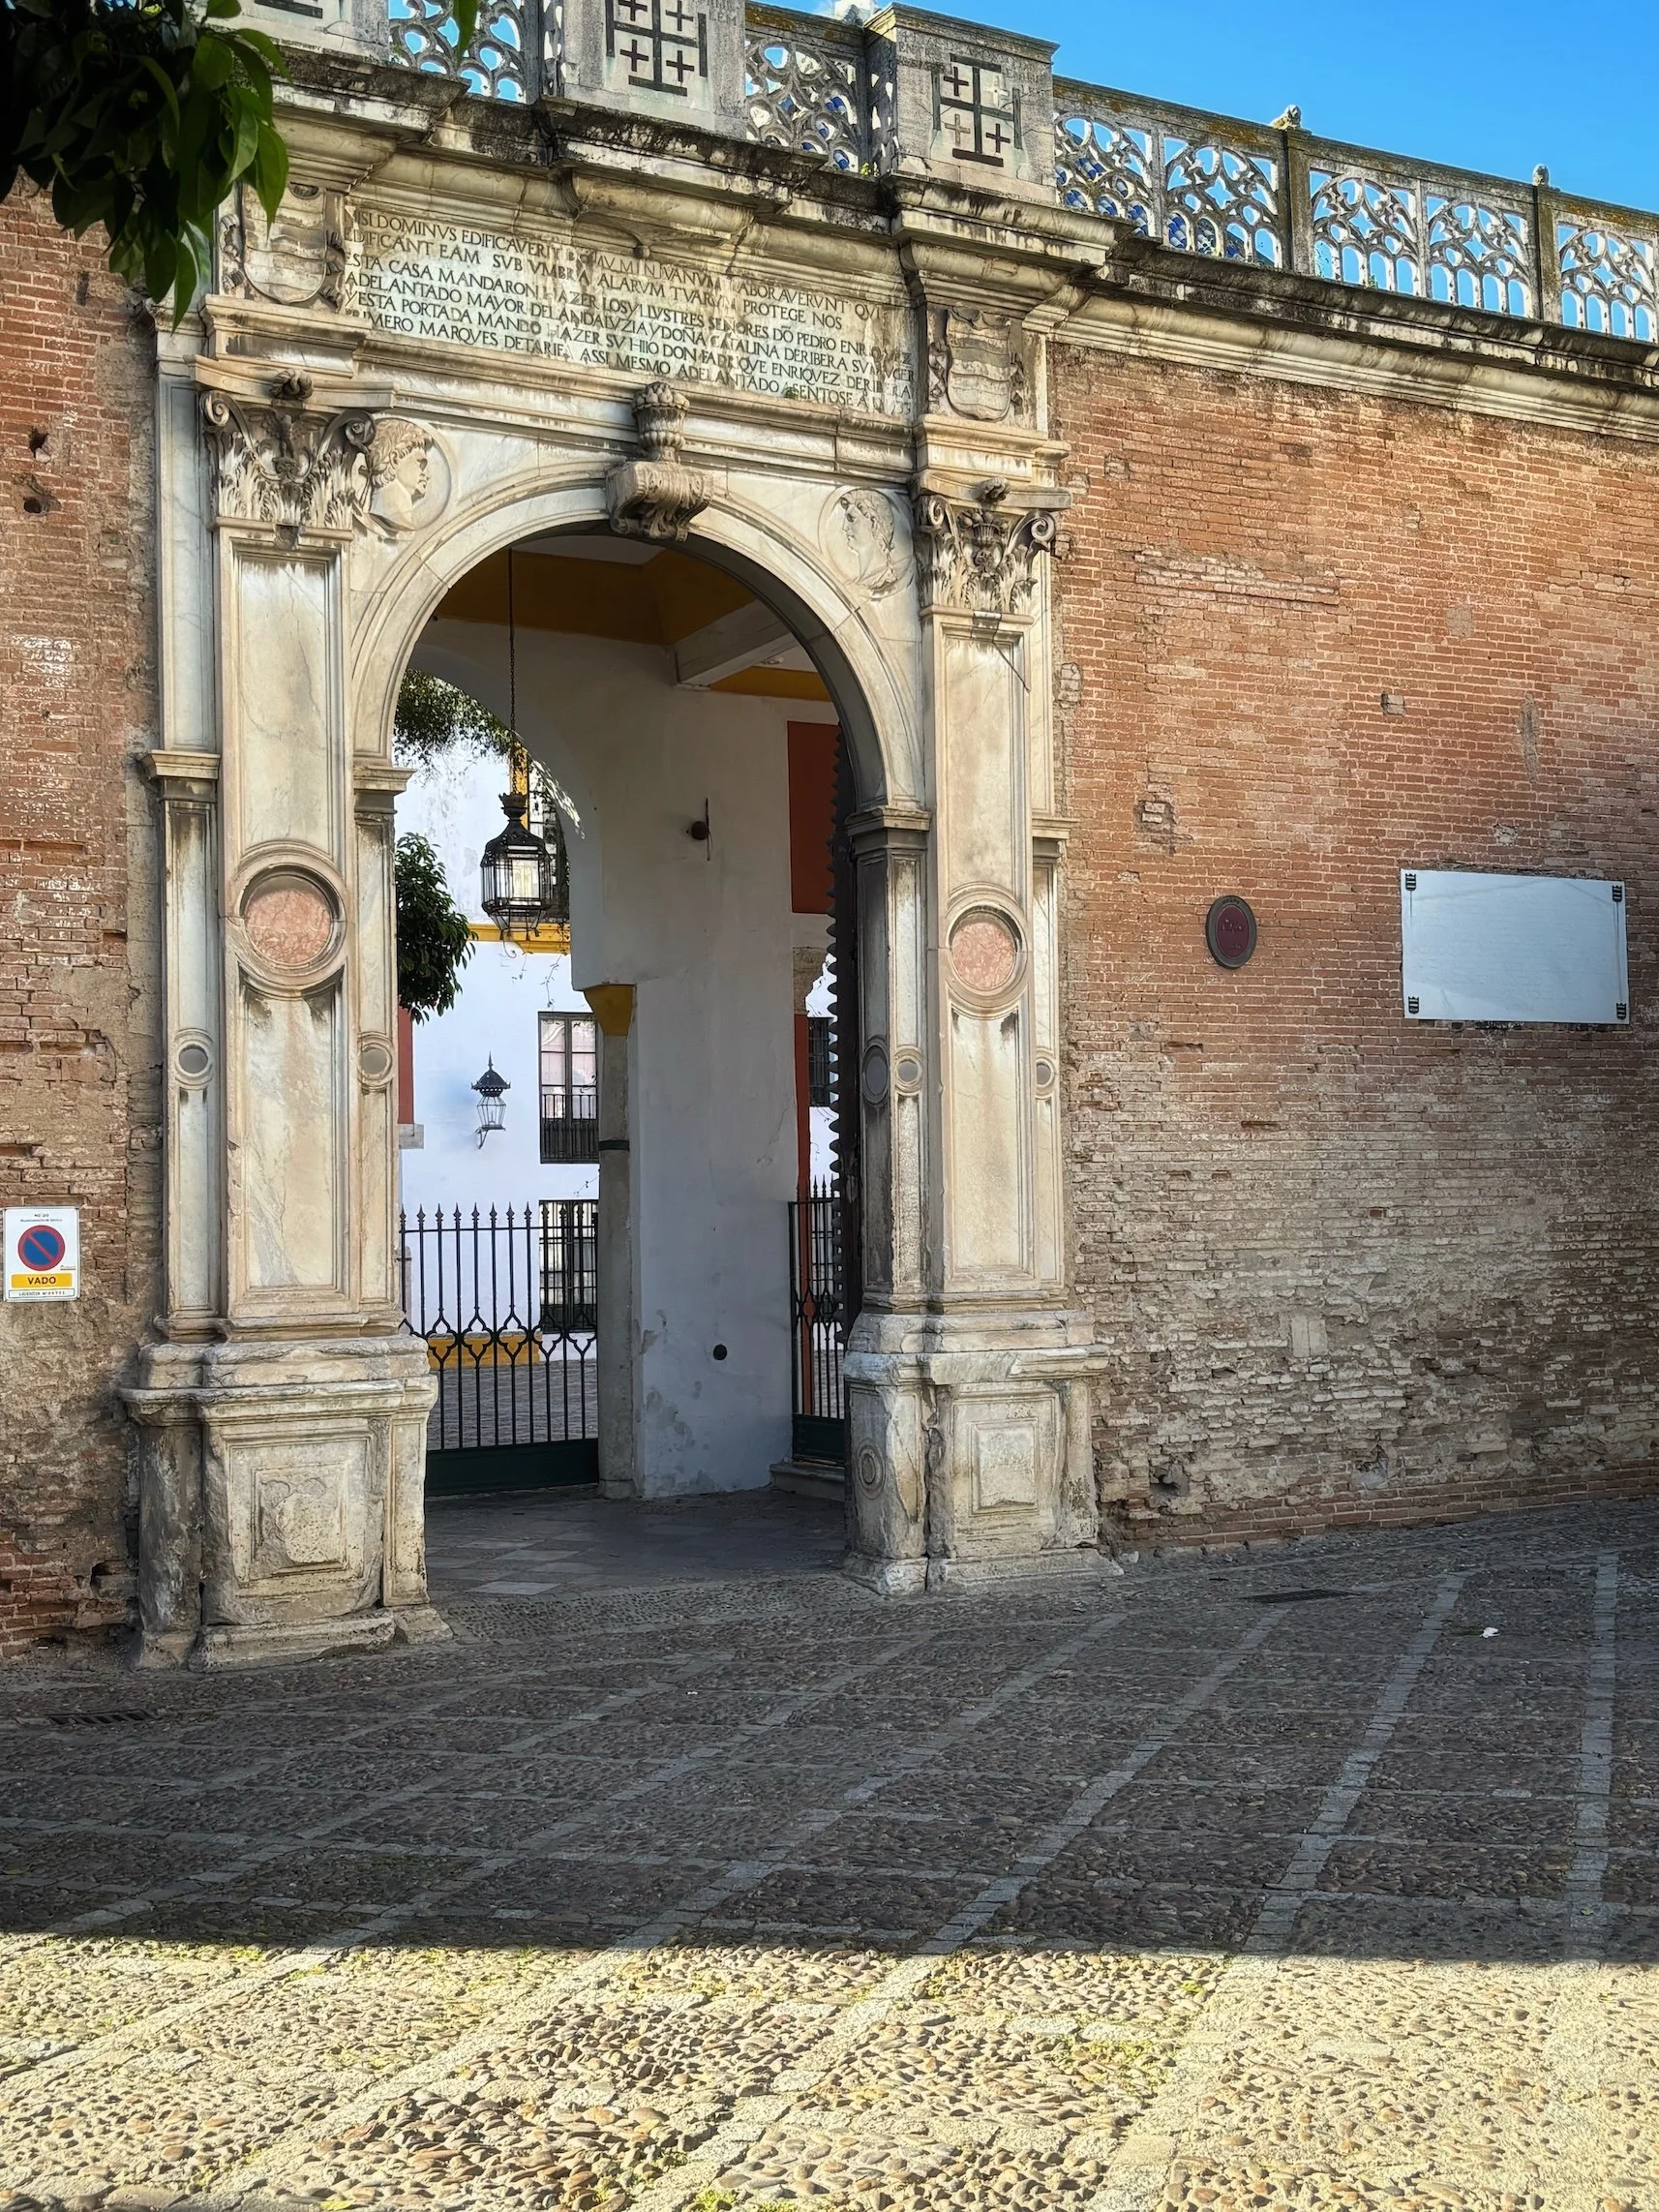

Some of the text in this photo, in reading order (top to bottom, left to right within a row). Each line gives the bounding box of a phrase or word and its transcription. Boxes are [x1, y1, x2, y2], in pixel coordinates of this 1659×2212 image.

[377, 215, 456, 241] DOMINVS
[344, 227, 434, 256] EDIFICANT
[439, 242, 480, 264] EAM
[493, 254, 524, 272] SVB
[528, 258, 590, 286] VMBRA
[597, 273, 666, 298] ALARVM
[743, 298, 805, 323] PROTEGE
[812, 313, 842, 330] NOS
[345, 271, 462, 303] ADELANTADO
[467, 291, 527, 315] MAYOR
[388, 258, 434, 281] CASA
[437, 267, 539, 299] MANDARON
[797, 331, 836, 351] PEDRO
[402, 299, 472, 323] PORTADA
[478, 312, 542, 335] MANDO
[606, 333, 628, 348] SV
[662, 344, 697, 362] DON
[771, 362, 840, 386] ENRIQVEZ
[419, 320, 498, 347] MARQVES
[617, 354, 670, 376] MESMO
[27, 1276, 56, 1286] VADO
